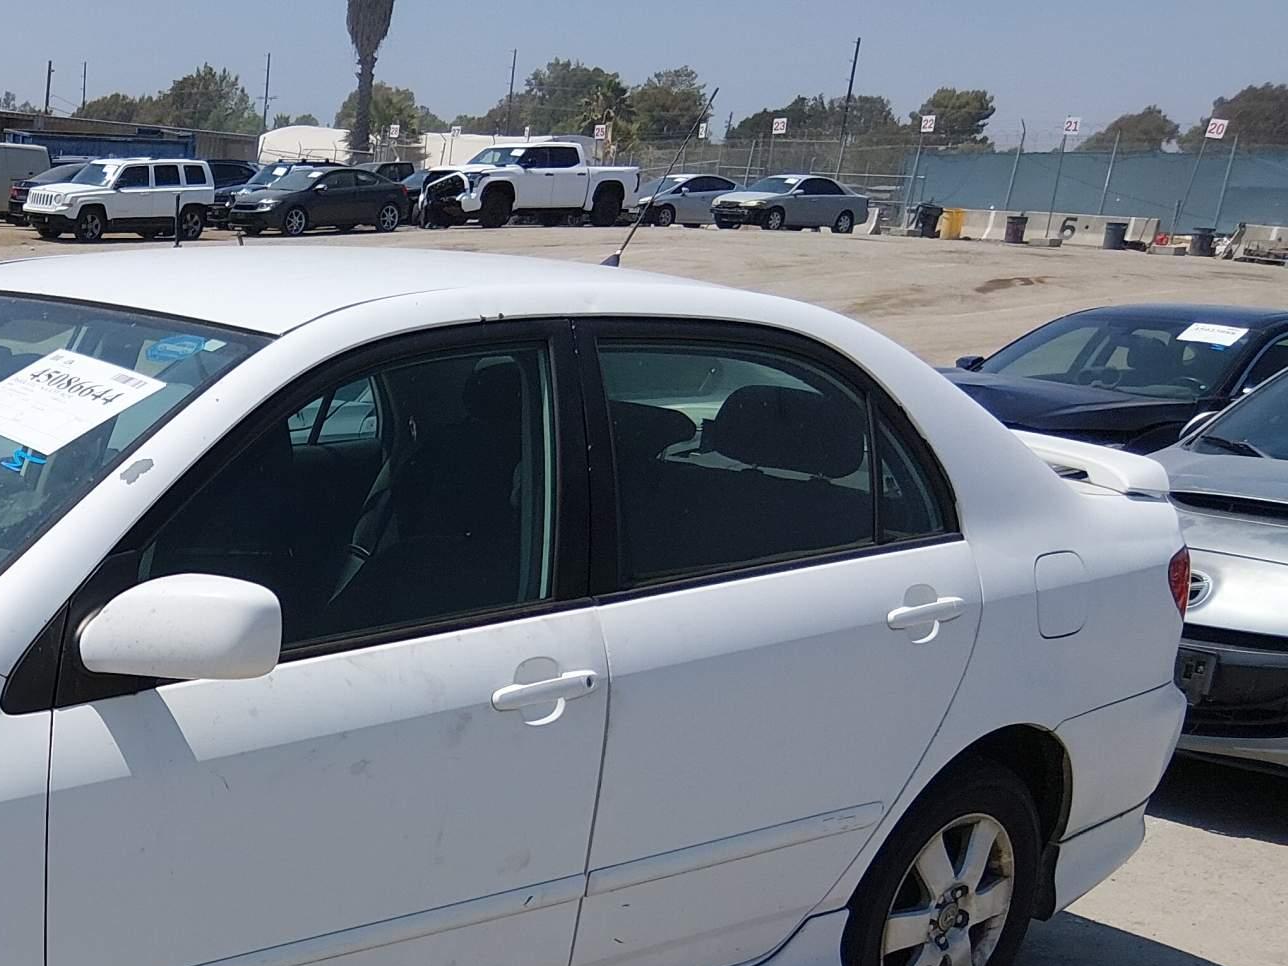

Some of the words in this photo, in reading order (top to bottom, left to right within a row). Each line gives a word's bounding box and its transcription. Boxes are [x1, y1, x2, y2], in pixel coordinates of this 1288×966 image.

[774, 121, 786, 131] 23
[922, 119, 934, 129] 22
[1065, 120, 1079, 131] 21
[1208, 122, 1224, 135] 20
[595, 127, 605, 137] 25
[30, 368, 124, 405] 45086644
